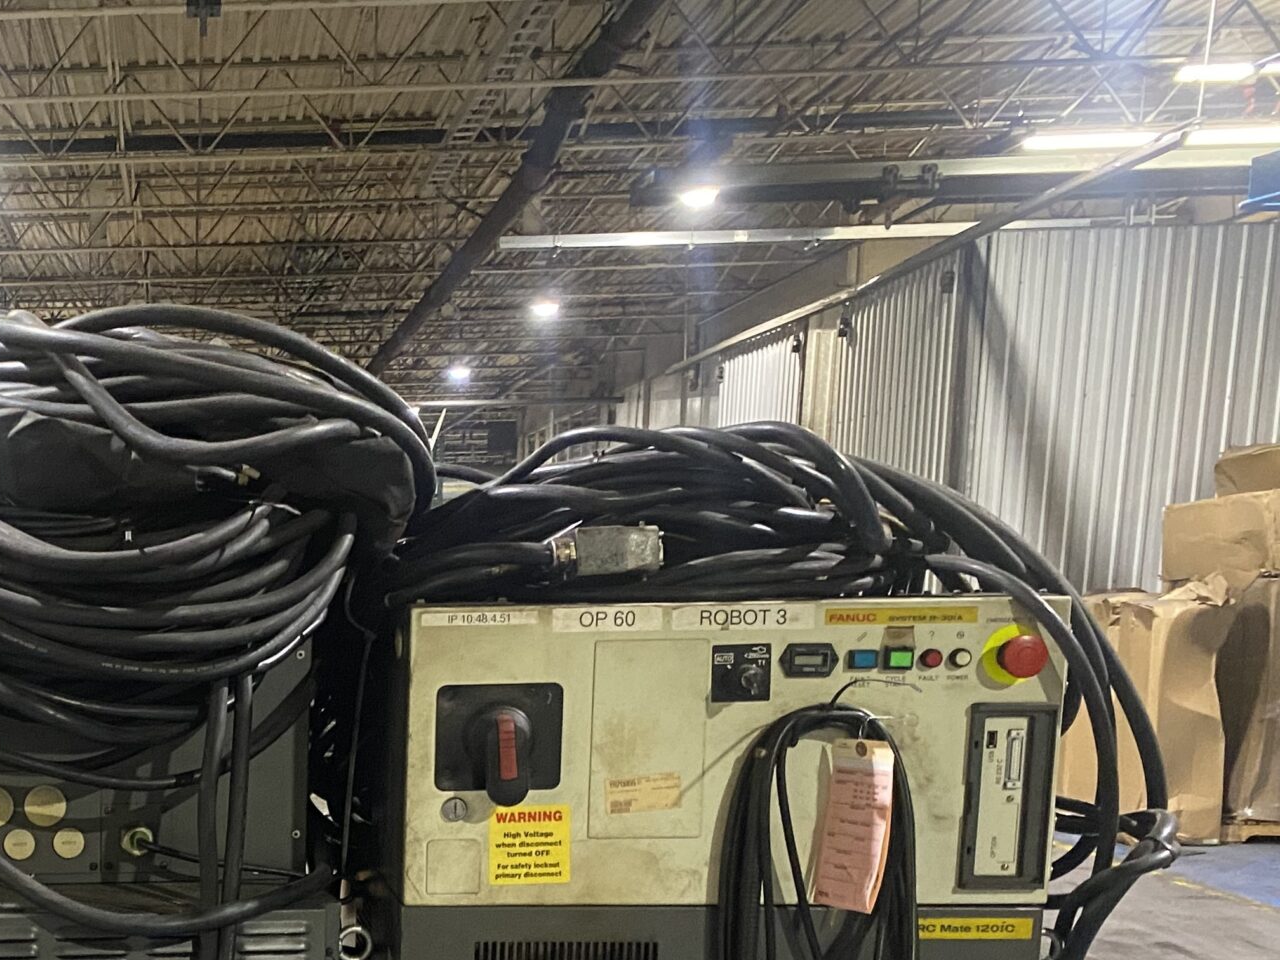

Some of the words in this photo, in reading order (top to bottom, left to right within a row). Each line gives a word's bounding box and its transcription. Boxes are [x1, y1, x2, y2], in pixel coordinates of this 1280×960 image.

[447, 614, 458, 624] IP
[461, 613, 511, 624] 10.48.4.51
[579, 611, 608, 628] OP
[613, 610, 637, 627] 60
[699, 608, 771, 626] ROBOT
[775, 608, 788, 625] 3
[828, 613, 877, 623] FANUC
[495, 809, 563, 824] WARNING
[503, 831, 522, 840] High
[523, 830, 554, 839] Voltage
[495, 841, 517, 849] when
[518, 839, 562, 848] disconnect
[506, 850, 533, 858] turned
[534, 849, 551, 857] OFF
[510, 862, 532, 870] safety
[533, 861, 560, 869] lockout
[494, 872, 522, 881] primary
[523, 869, 562, 878] disconnect
[918, 923, 937, 933] RC
[939, 924, 972, 933] Mate
